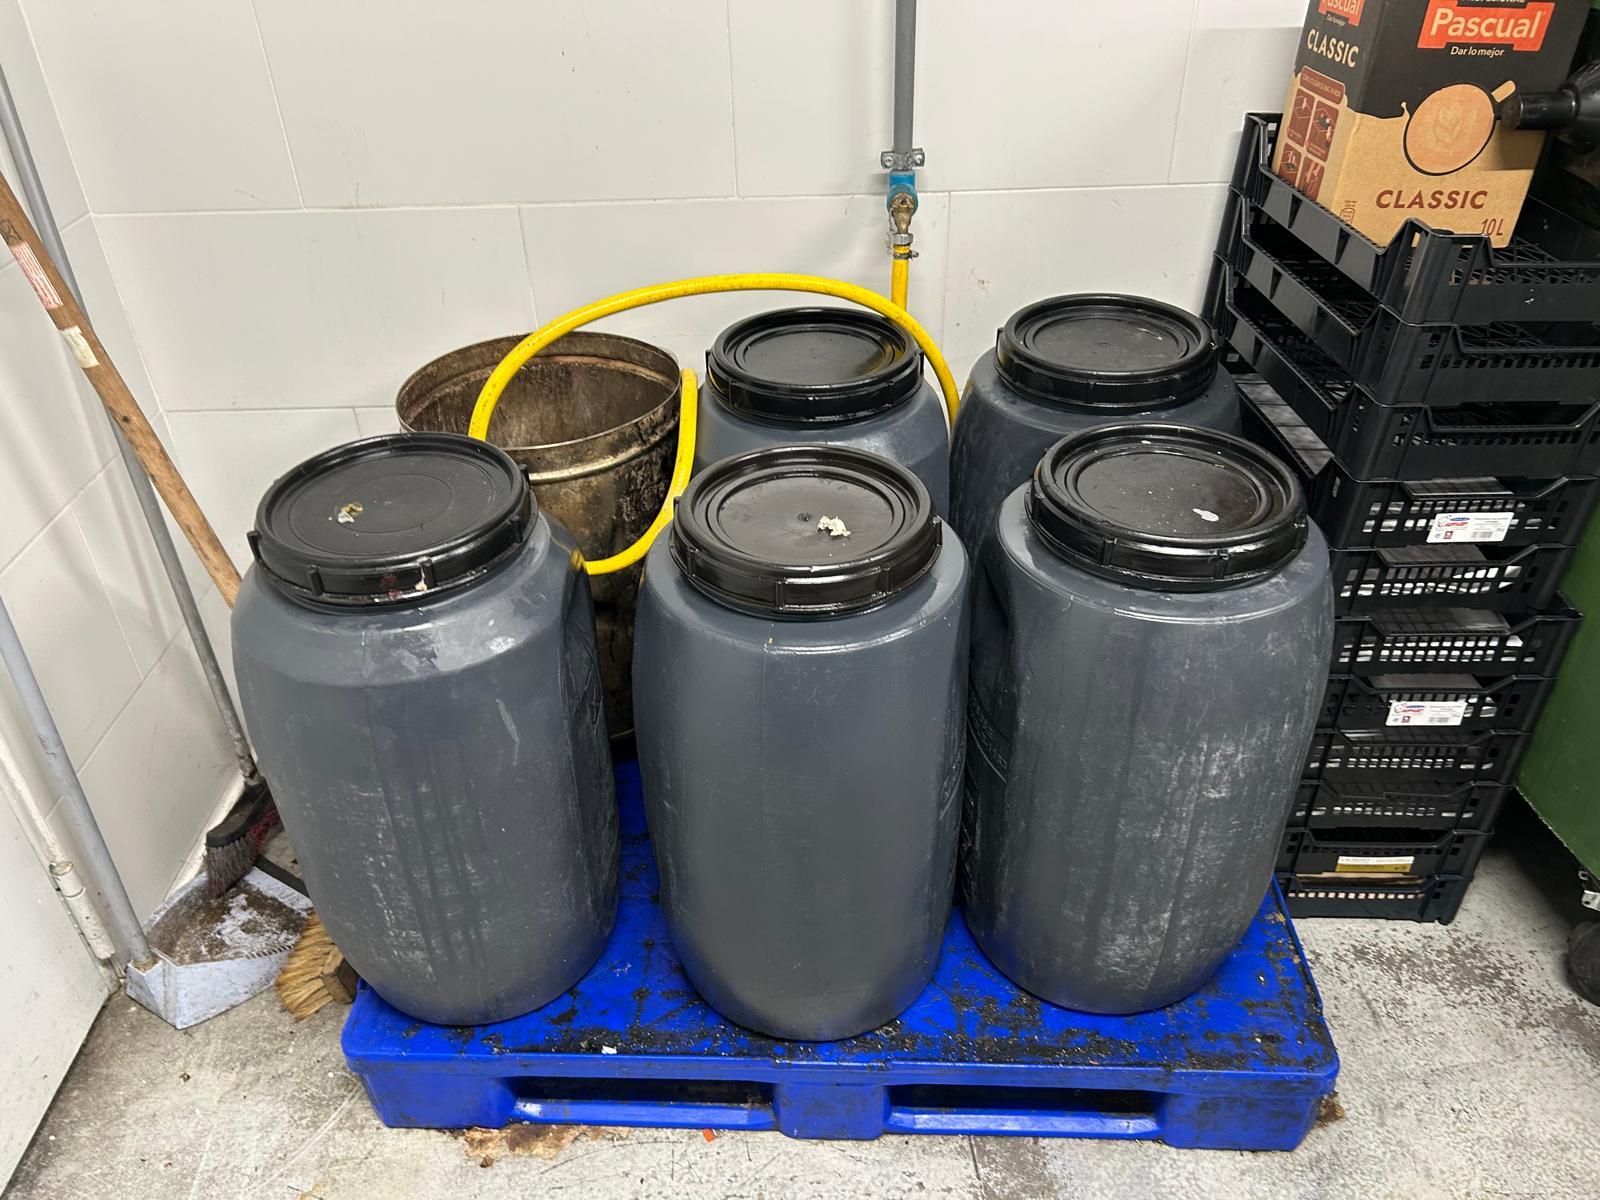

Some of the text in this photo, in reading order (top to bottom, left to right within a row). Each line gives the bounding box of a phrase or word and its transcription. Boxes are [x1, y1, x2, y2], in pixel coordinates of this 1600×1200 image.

[1322, 0, 1360, 15] ascual
[1430, 8, 1542, 38] Pascual
[1307, 28, 1359, 68] CLASSIC
[1450, 46, 1505, 58] Dar lo mejor
[1376, 190, 1488, 209] CLASSIC
